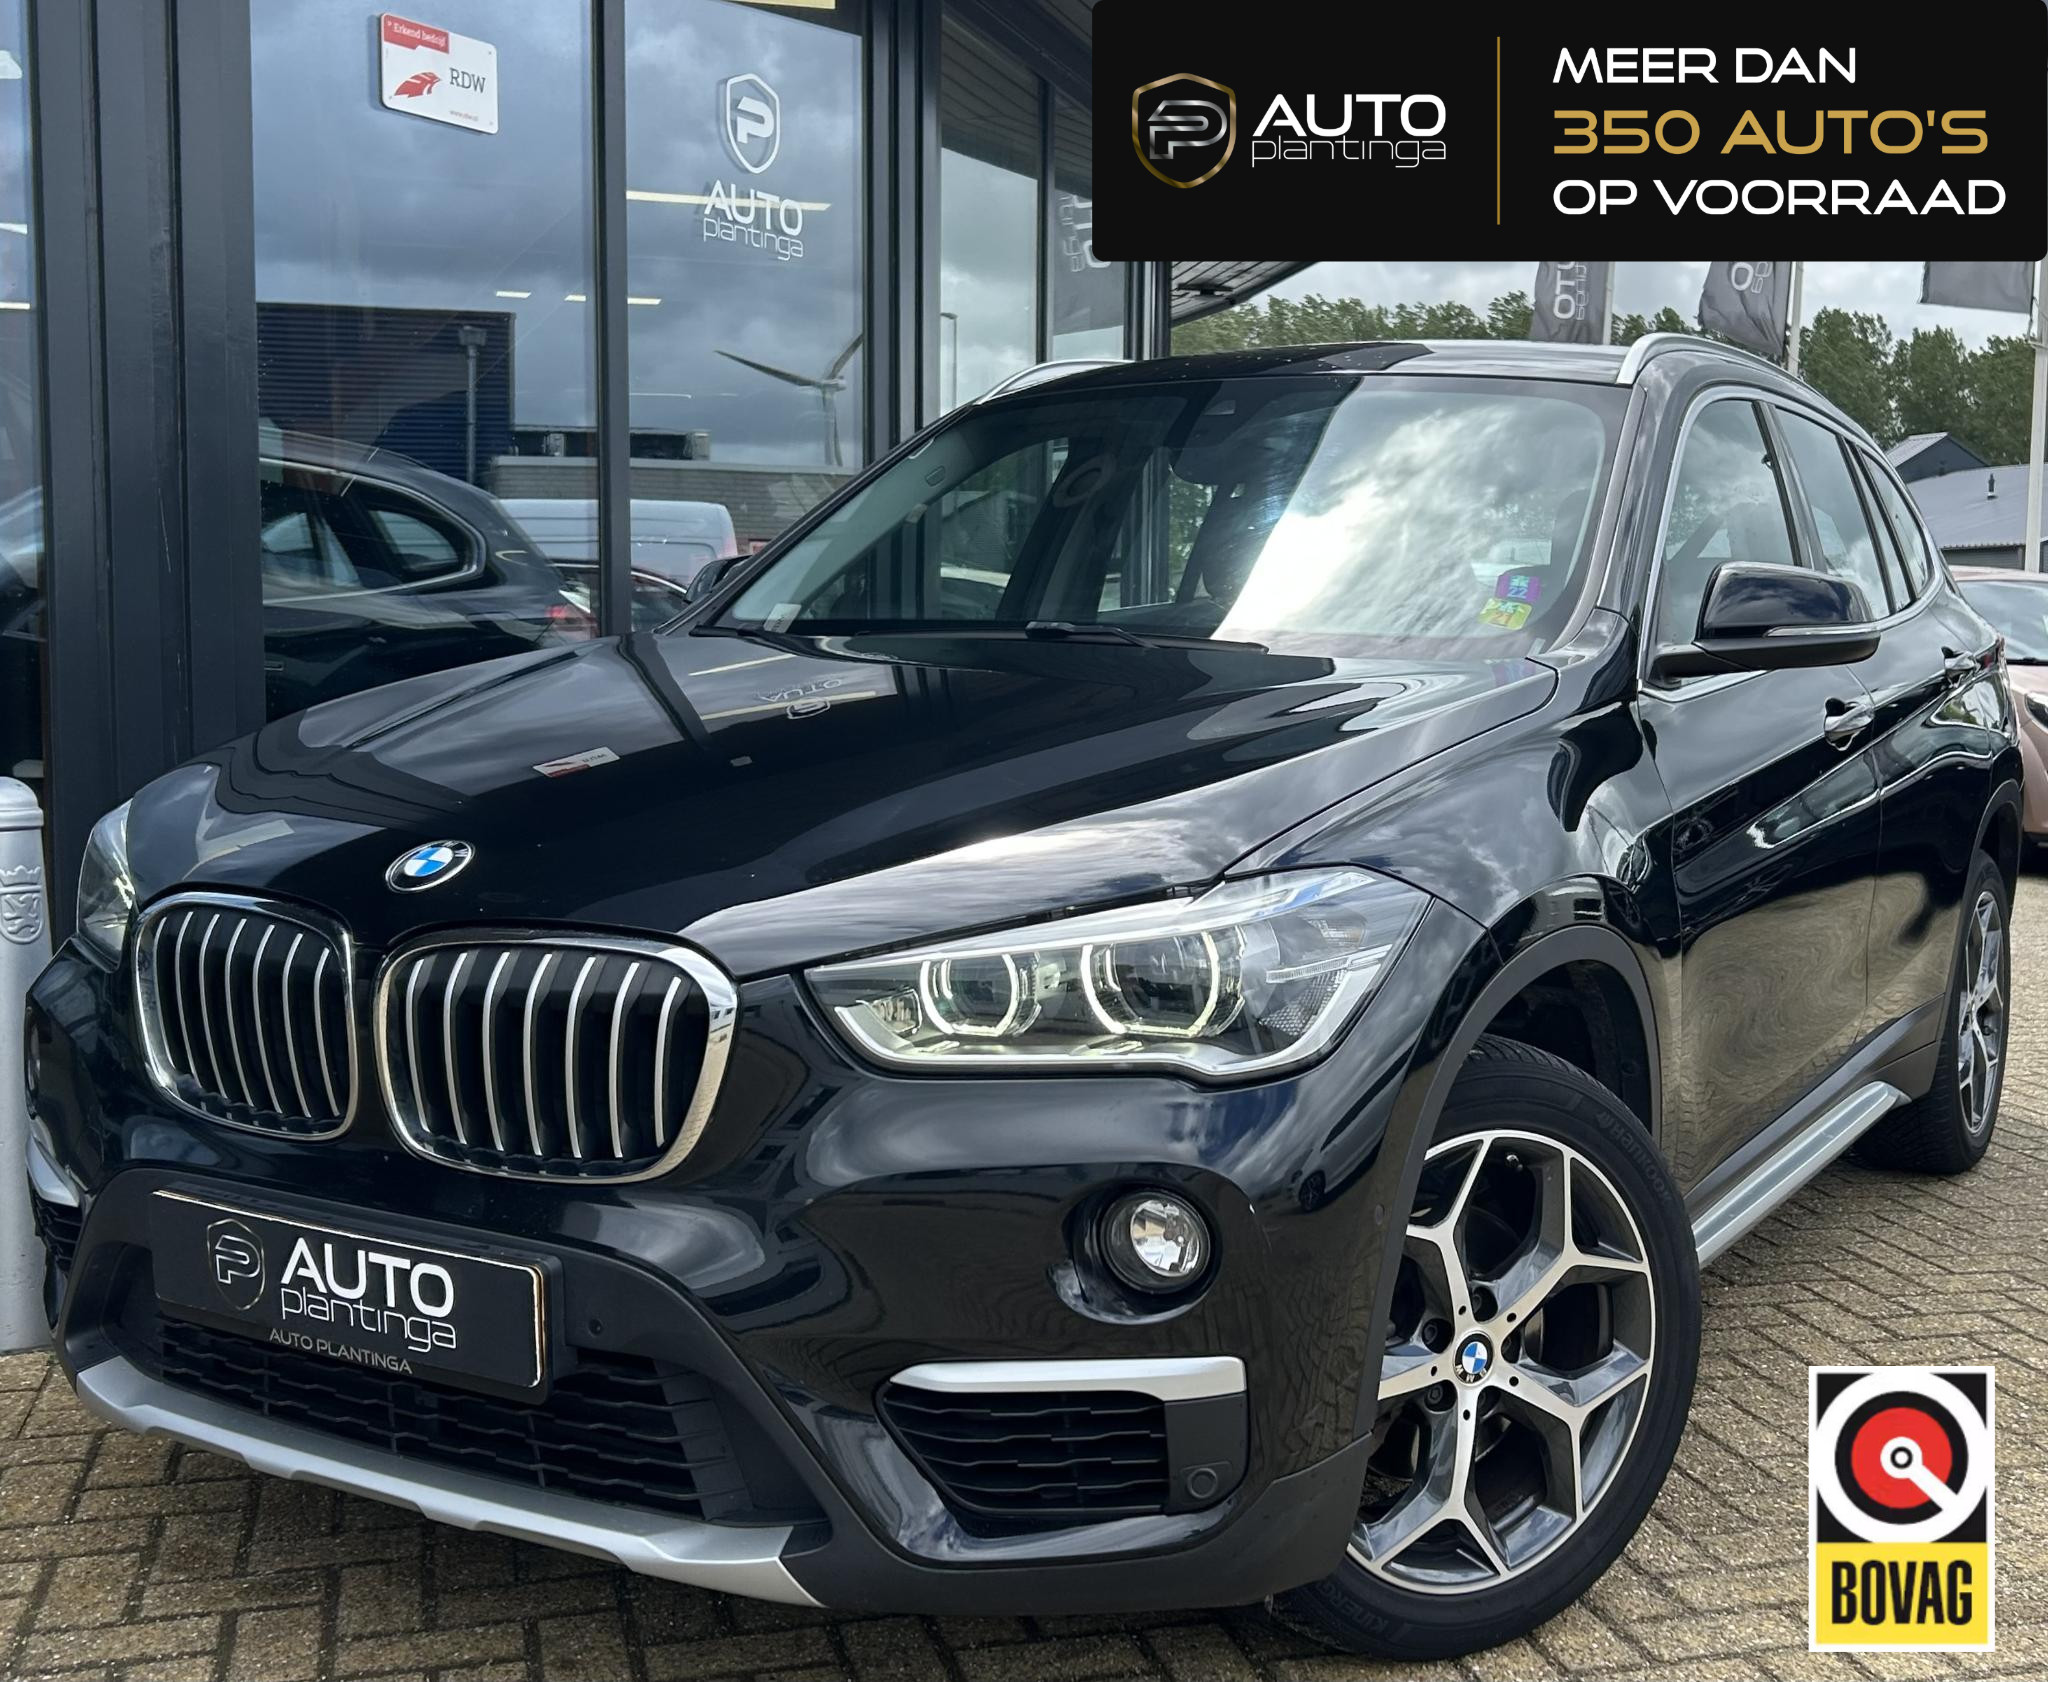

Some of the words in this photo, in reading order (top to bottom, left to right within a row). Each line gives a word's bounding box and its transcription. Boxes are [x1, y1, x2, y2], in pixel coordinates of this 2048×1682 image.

[449, 67, 486, 94] RDW
[704, 179, 803, 236] AUTO
[703, 216, 804, 261] plantinga
[280, 1237, 454, 1318] AUTO
[280, 1286, 457, 1353] plantinga
[268, 1327, 314, 1351] AUTO
[316, 1339, 414, 1375] PLANTINGA
